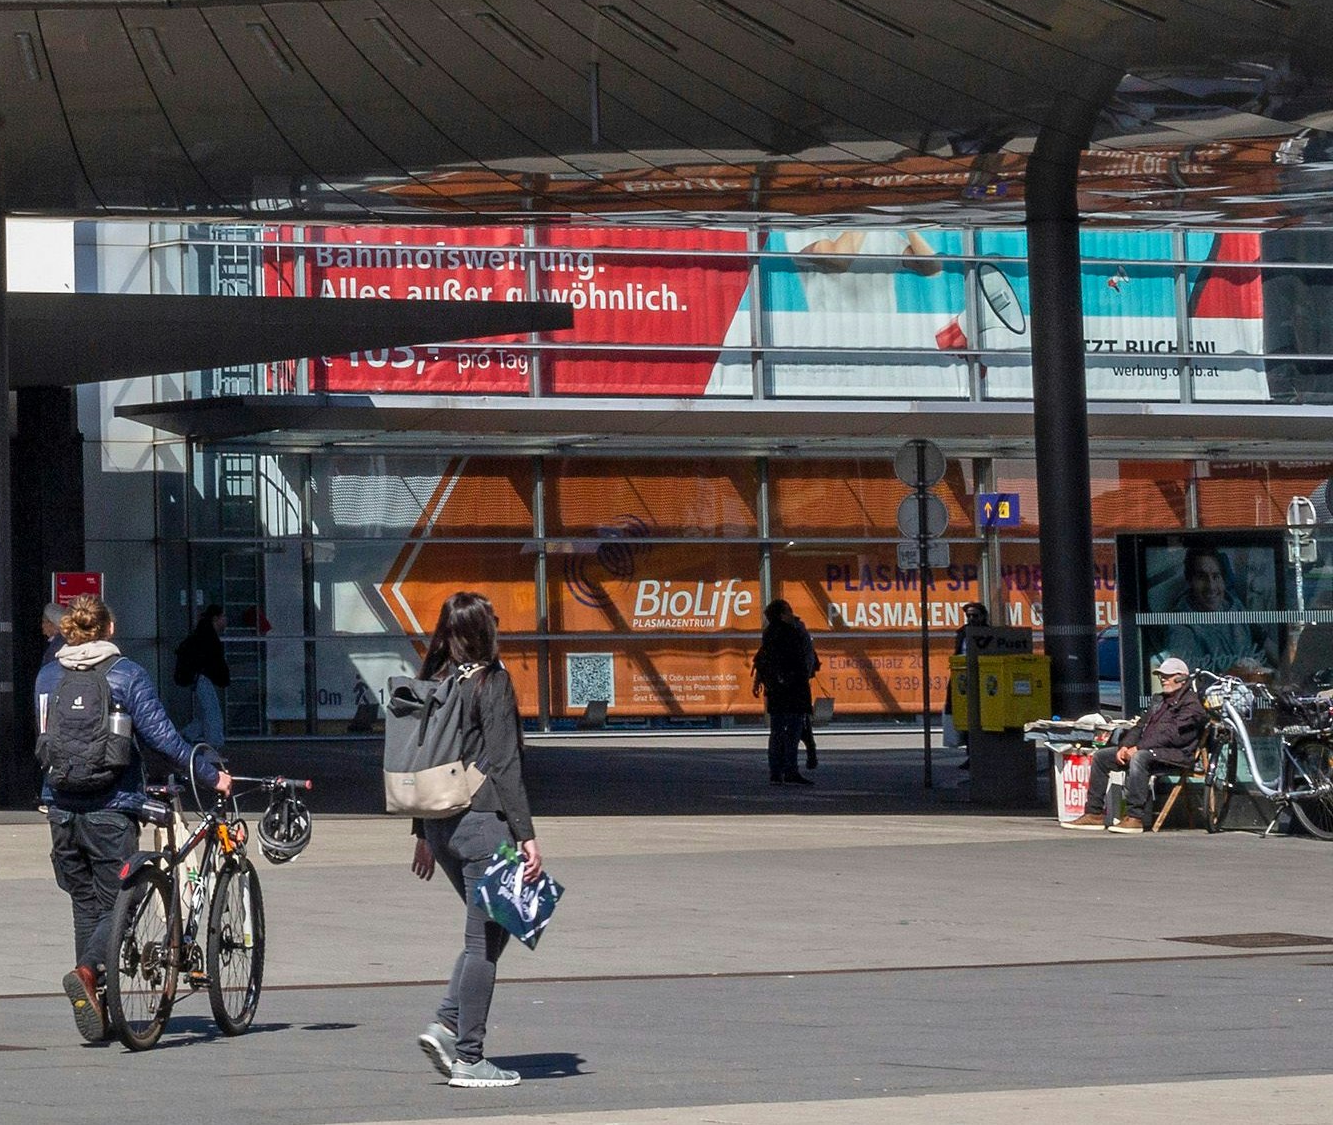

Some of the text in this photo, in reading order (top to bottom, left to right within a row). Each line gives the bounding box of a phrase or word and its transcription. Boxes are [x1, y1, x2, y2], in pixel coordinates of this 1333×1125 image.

[317, 241, 605, 280] Bahnhofswerung.
[319, 277, 687, 311] Alles außer gwöhnlich.
[1126, 340, 1215, 354] BUCHN!
[457, 352, 491, 372] pro
[497, 350, 529, 375] Tag
[947, 564, 1043, 591] SPNDE
[634, 578, 752, 628] BioLife
[828, 601, 1023, 627] PLASMAZENTM
[633, 618, 715, 628] PLASMAZENTRUM
[997, 638, 1027, 649] Post
[299, 689, 341, 705] 10m
